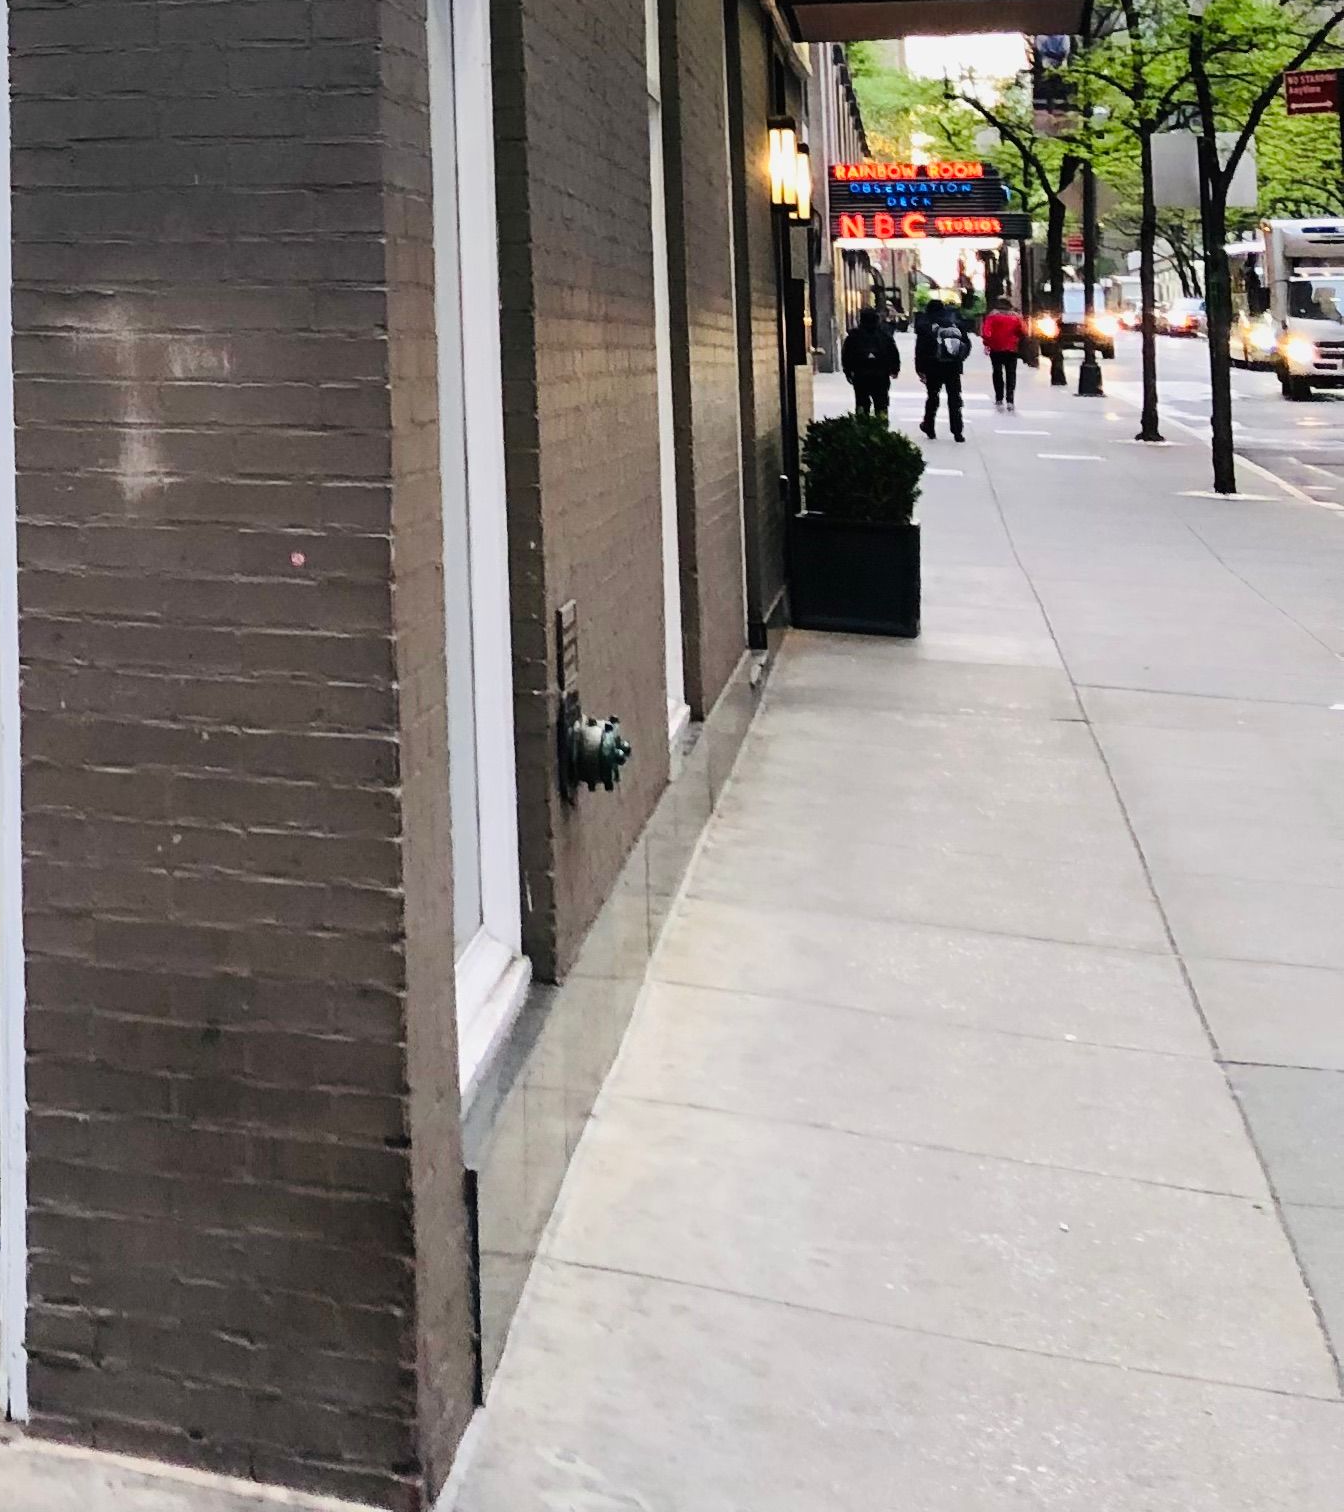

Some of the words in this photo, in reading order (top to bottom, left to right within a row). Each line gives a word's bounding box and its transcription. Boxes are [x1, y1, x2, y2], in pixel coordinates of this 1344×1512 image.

[834, 162, 917, 180] RAINBOW
[925, 161, 984, 179] ROOM
[849, 182, 973, 193] OBSERVATION
[886, 196, 932, 207] DECK
[839, 212, 927, 238] NBC
[934, 217, 1002, 234] STUDIOS
